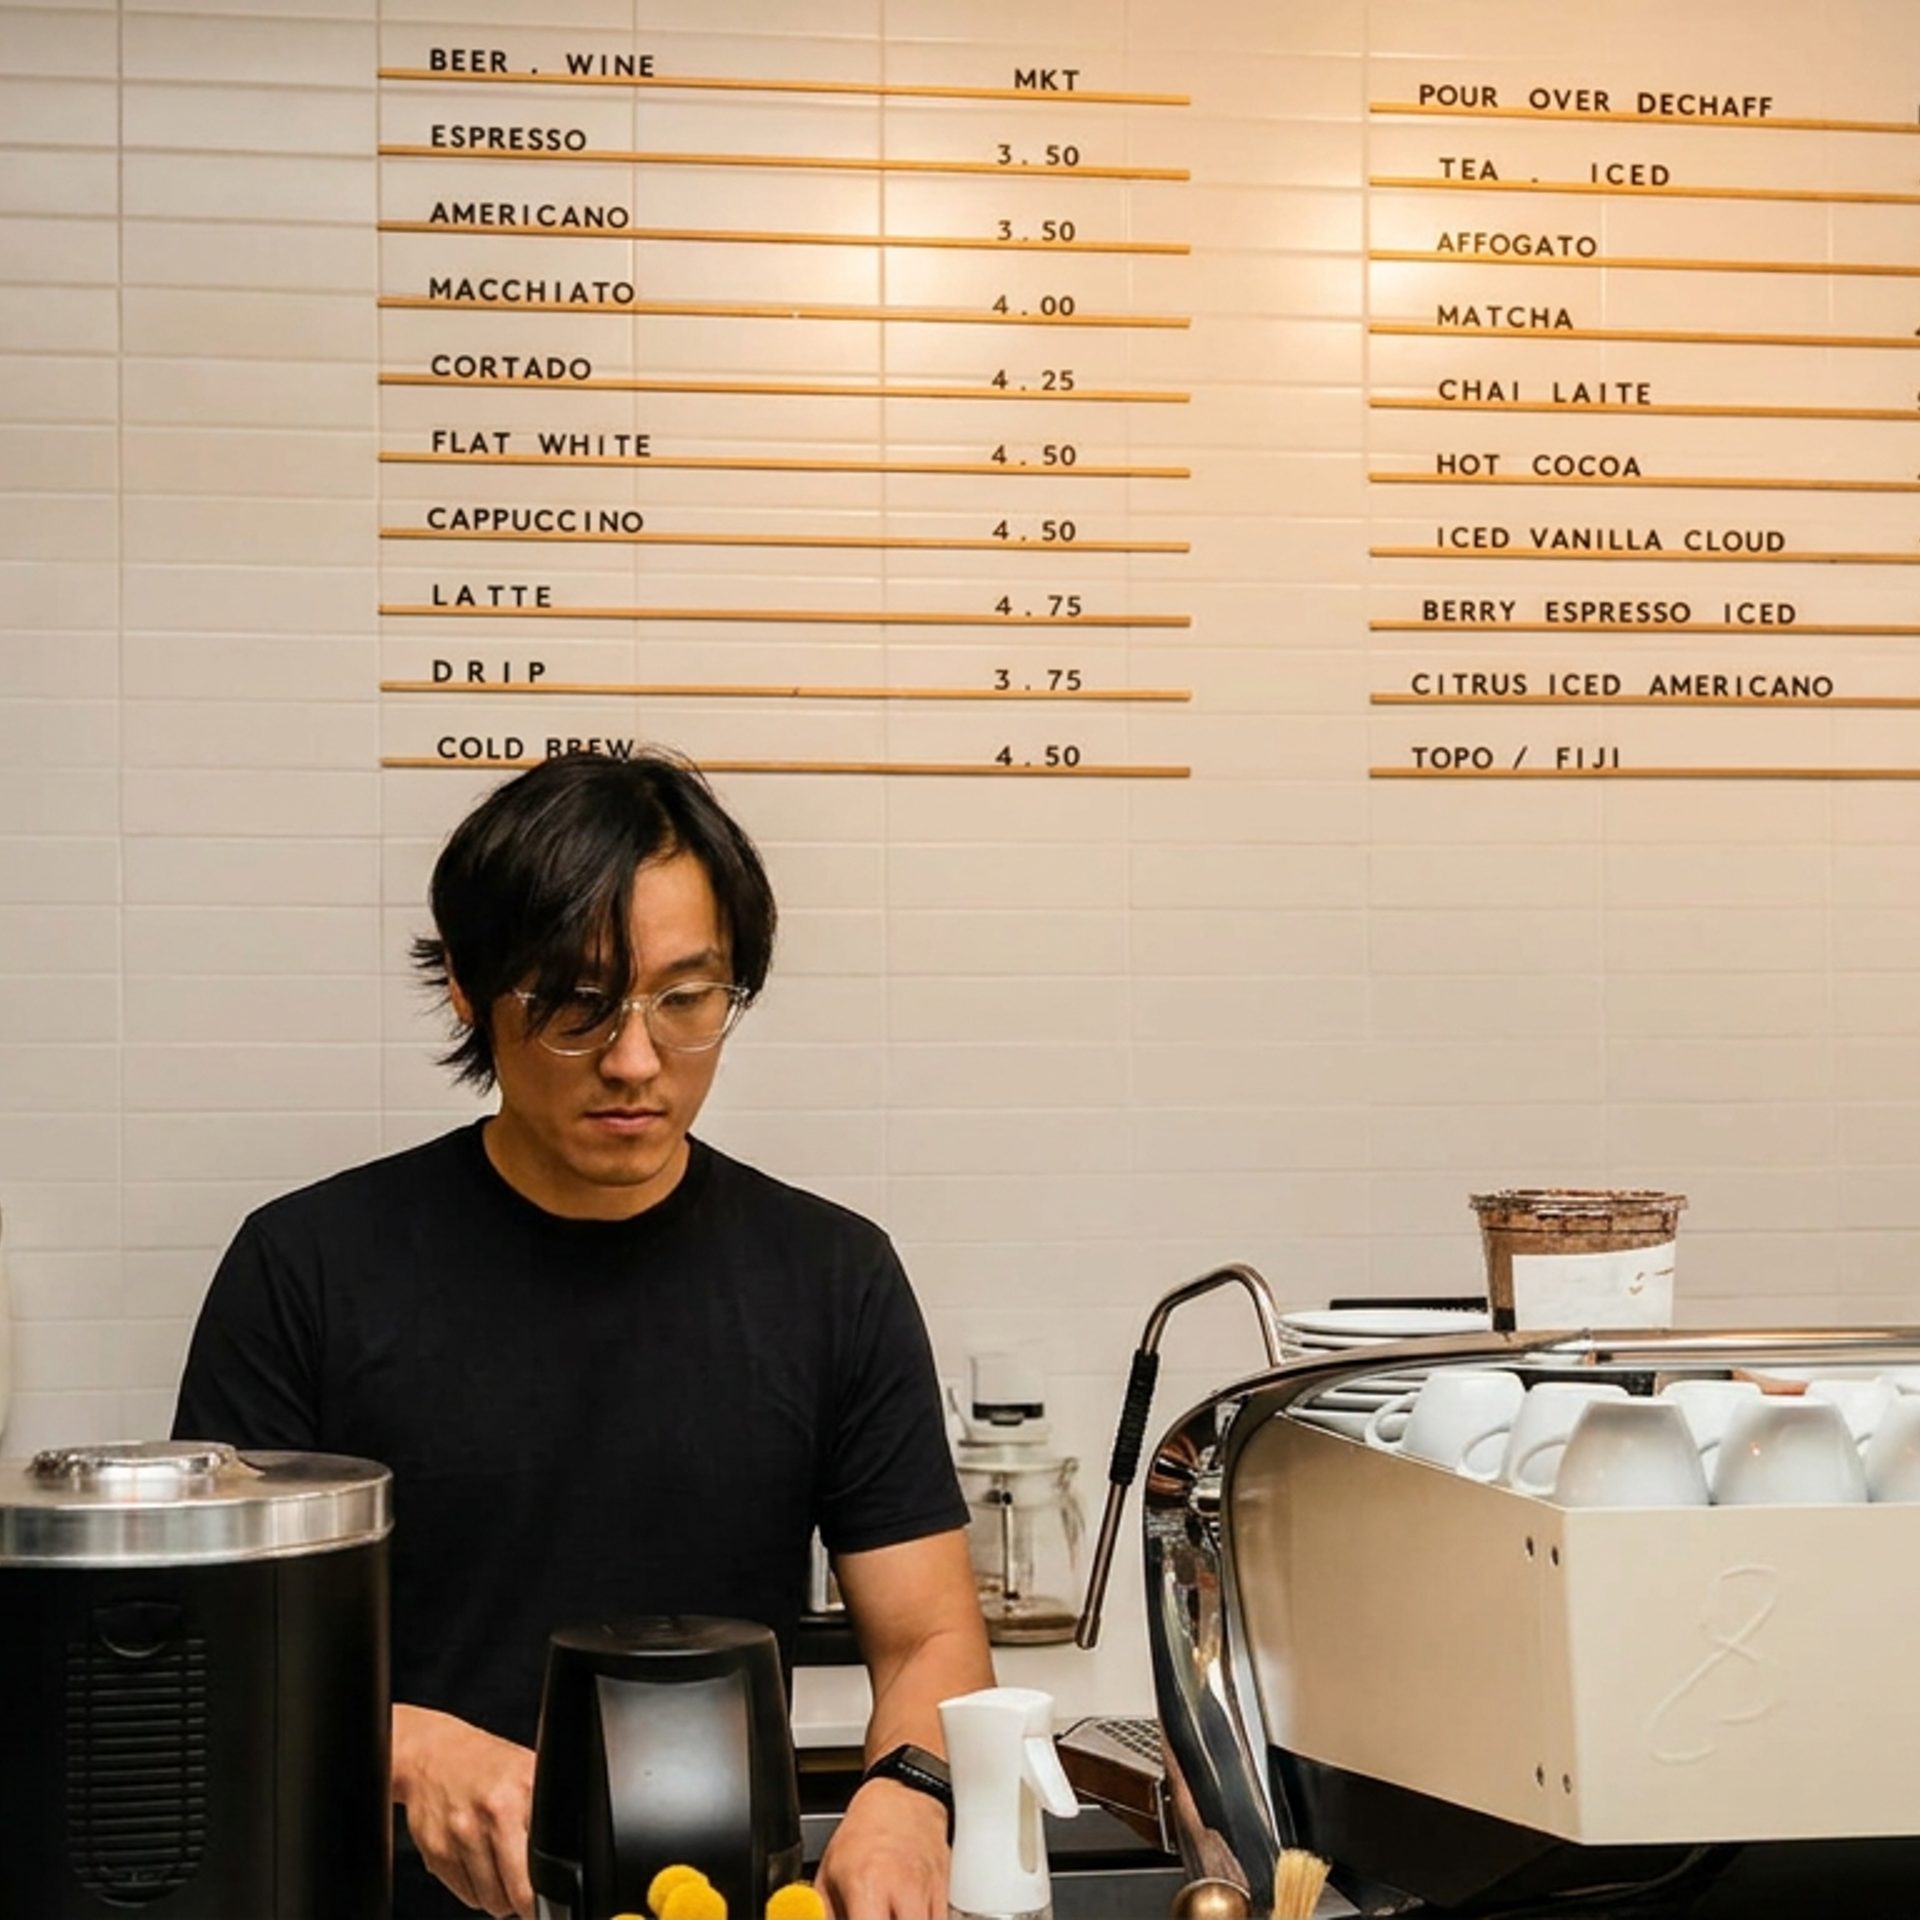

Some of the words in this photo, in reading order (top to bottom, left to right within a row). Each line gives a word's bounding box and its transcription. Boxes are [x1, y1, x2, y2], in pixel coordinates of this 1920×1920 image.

[429, 48, 508, 73] BEER
[566, 53, 656, 78] WINE
[1014, 68, 1080, 91] MKT
[1418, 83, 1498, 108] POUR
[1529, 87, 1611, 113] OVER
[1637, 92, 1774, 118] DECHAFF
[431, 125, 587, 152] ESPRESSO
[1439, 157, 1498, 182] TEA
[1591, 162, 1671, 186] ICED
[429, 202, 629, 229] AMERICANO
[1436, 232, 1597, 258] AFFOGATO
[429, 277, 635, 305] MACCHIATO
[1436, 305, 1574, 329] MATCHA
[431, 354, 592, 381] CORTADO
[1438, 379, 1519, 402] CHAI
[432, 430, 512, 454] FLAT
[538, 432, 651, 457] WHITE
[1436, 454, 1500, 476] HOT
[1532, 454, 1641, 477] COCOA
[427, 507, 644, 533] CAPPUCCINO
[1437, 526, 1510, 549] ICED
[1530, 527, 1663, 551] VANILLA
[1684, 530, 1786, 553] CLOUD
[433, 584, 552, 608] LATTE
[1422, 600, 1516, 622] BERRY
[1545, 601, 1692, 624] ESPRESSO
[1725, 602, 1797, 625] ICED
[433, 660, 547, 684] DRIP
[1411, 673, 1528, 696] CITRUS
[1549, 673, 1622, 697] ICED
[1648, 675, 1835, 698] AMERICANO
[437, 736, 524, 760] COLD
[1411, 746, 1494, 769] TOPO
[1512, 746, 1528, 770] /
[1555, 746, 1620, 770] FIJI
